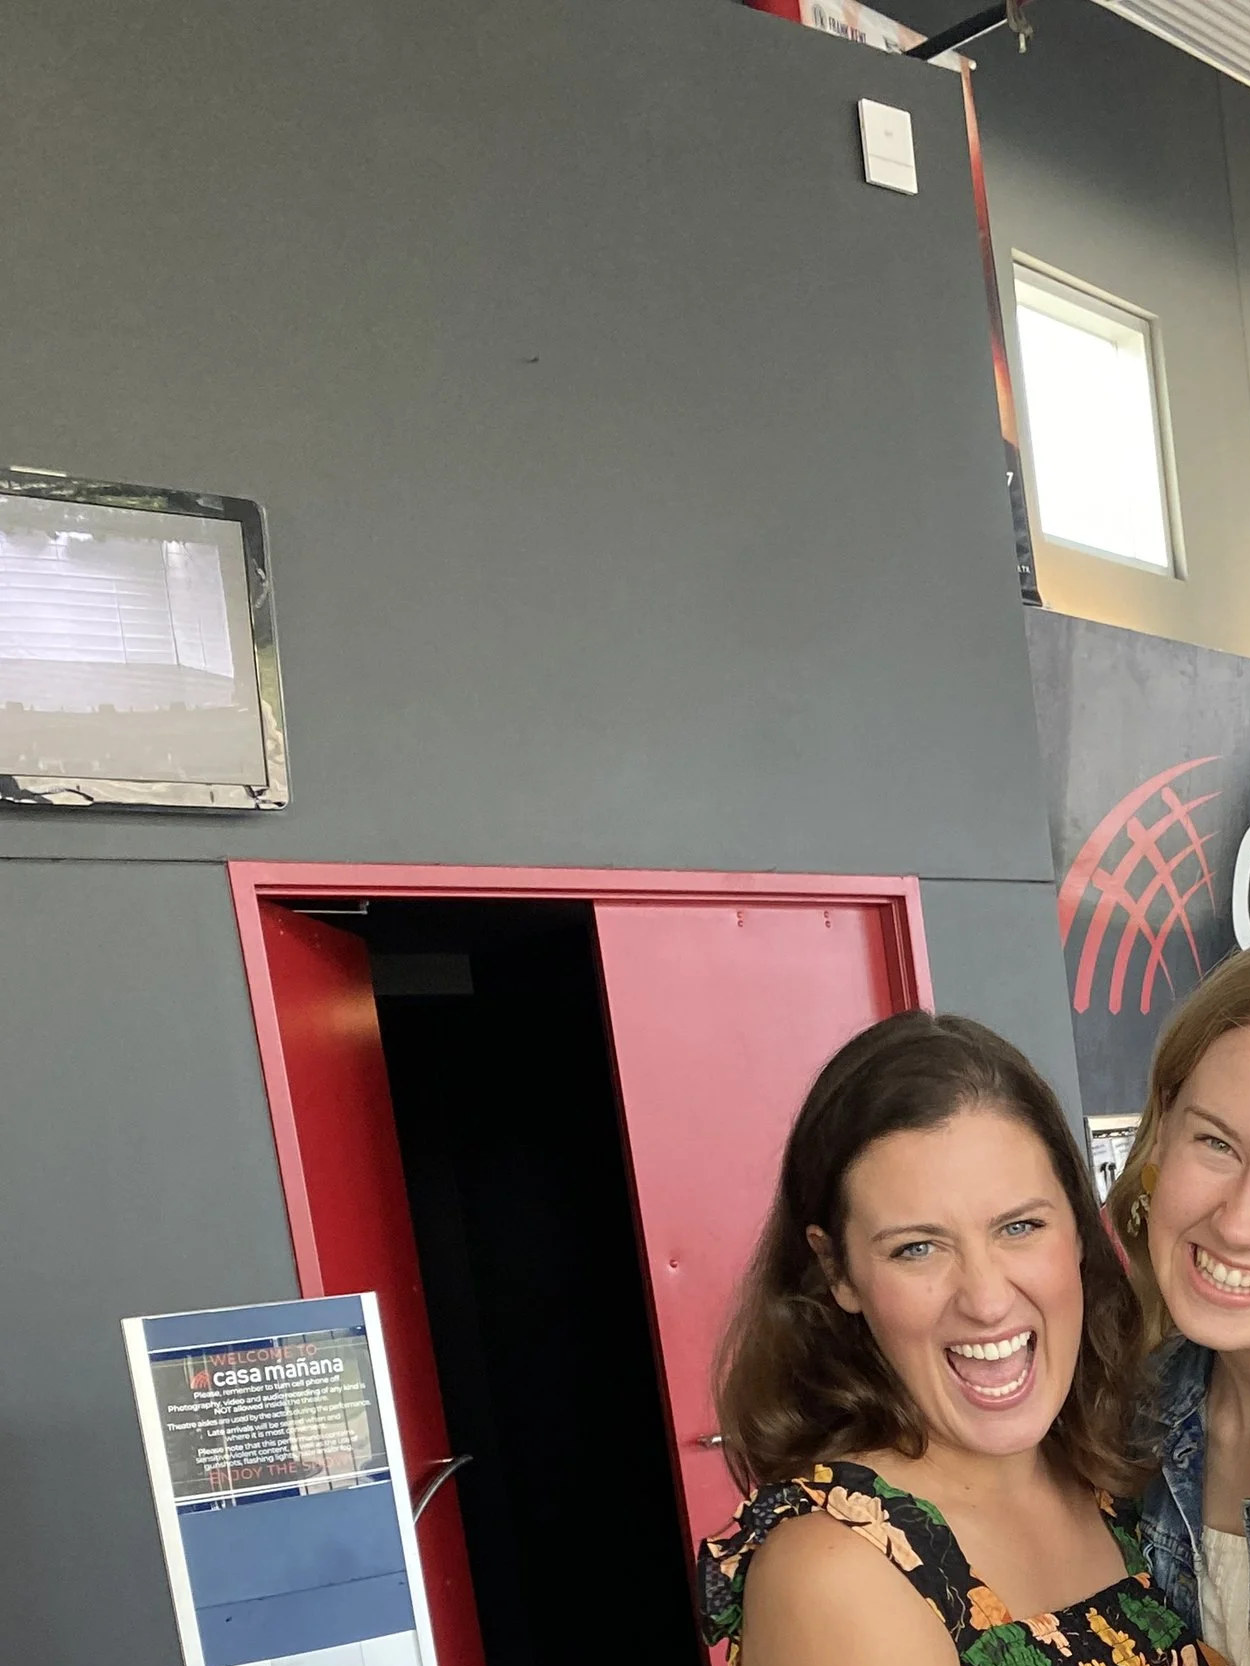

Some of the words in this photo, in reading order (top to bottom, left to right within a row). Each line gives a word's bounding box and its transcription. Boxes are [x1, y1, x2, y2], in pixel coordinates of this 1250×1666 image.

[209, 1347, 292, 1367] WELCOME
[296, 1344, 317, 1357] TO
[213, 1367, 262, 1387] casa
[265, 1357, 344, 1381] mañana
[222, 1384, 264, 1397] remember
[264, 1383, 274, 1391] to
[274, 1381, 292, 1390] turn
[292, 1379, 305, 1388] cell
[306, 1376, 329, 1388] phone
[168, 1399, 223, 1413] Photography,
[223, 1397, 245, 1407] video
[246, 1394, 262, 1404] and
[262, 1391, 284, 1402] audio
[284, 1388, 321, 1400] recording
[330, 1384, 343, 1394] any
[343, 1382, 359, 1391] kind
[214, 1406, 233, 1416] NOT
[234, 1402, 264, 1413] allowed
[264, 1400, 286, 1410] inside
[286, 1397, 300, 1406] the
[167, 1420, 197, 1432] Theatre
[197, 1417, 218, 1428] aisles
[231, 1414, 249, 1424] used
[259, 1411, 272, 1421] the
[272, 1408, 293, 1419] actors
[293, 1406, 317, 1417] during
[317, 1404, 329, 1413] the
[207, 1428, 226, 1438] Late
[226, 1423, 254, 1435] arrivals
[254, 1422, 268, 1432] will
[268, 1421, 280, 1430] be
[306, 1414, 326, 1424] when
[326, 1412, 341, 1422] and
[226, 1432, 250, 1442] where
[265, 1427, 286, 1437] most
[198, 1445, 224, 1457] Please
[226, 1444, 244, 1453] note
[244, 1442, 261, 1451] that
[262, 1439, 277, 1449] this
[244, 1454, 275, 1467] flashing
[209, 1467, 262, 1483] ENJOY
[268, 1462, 297, 1476] THE
